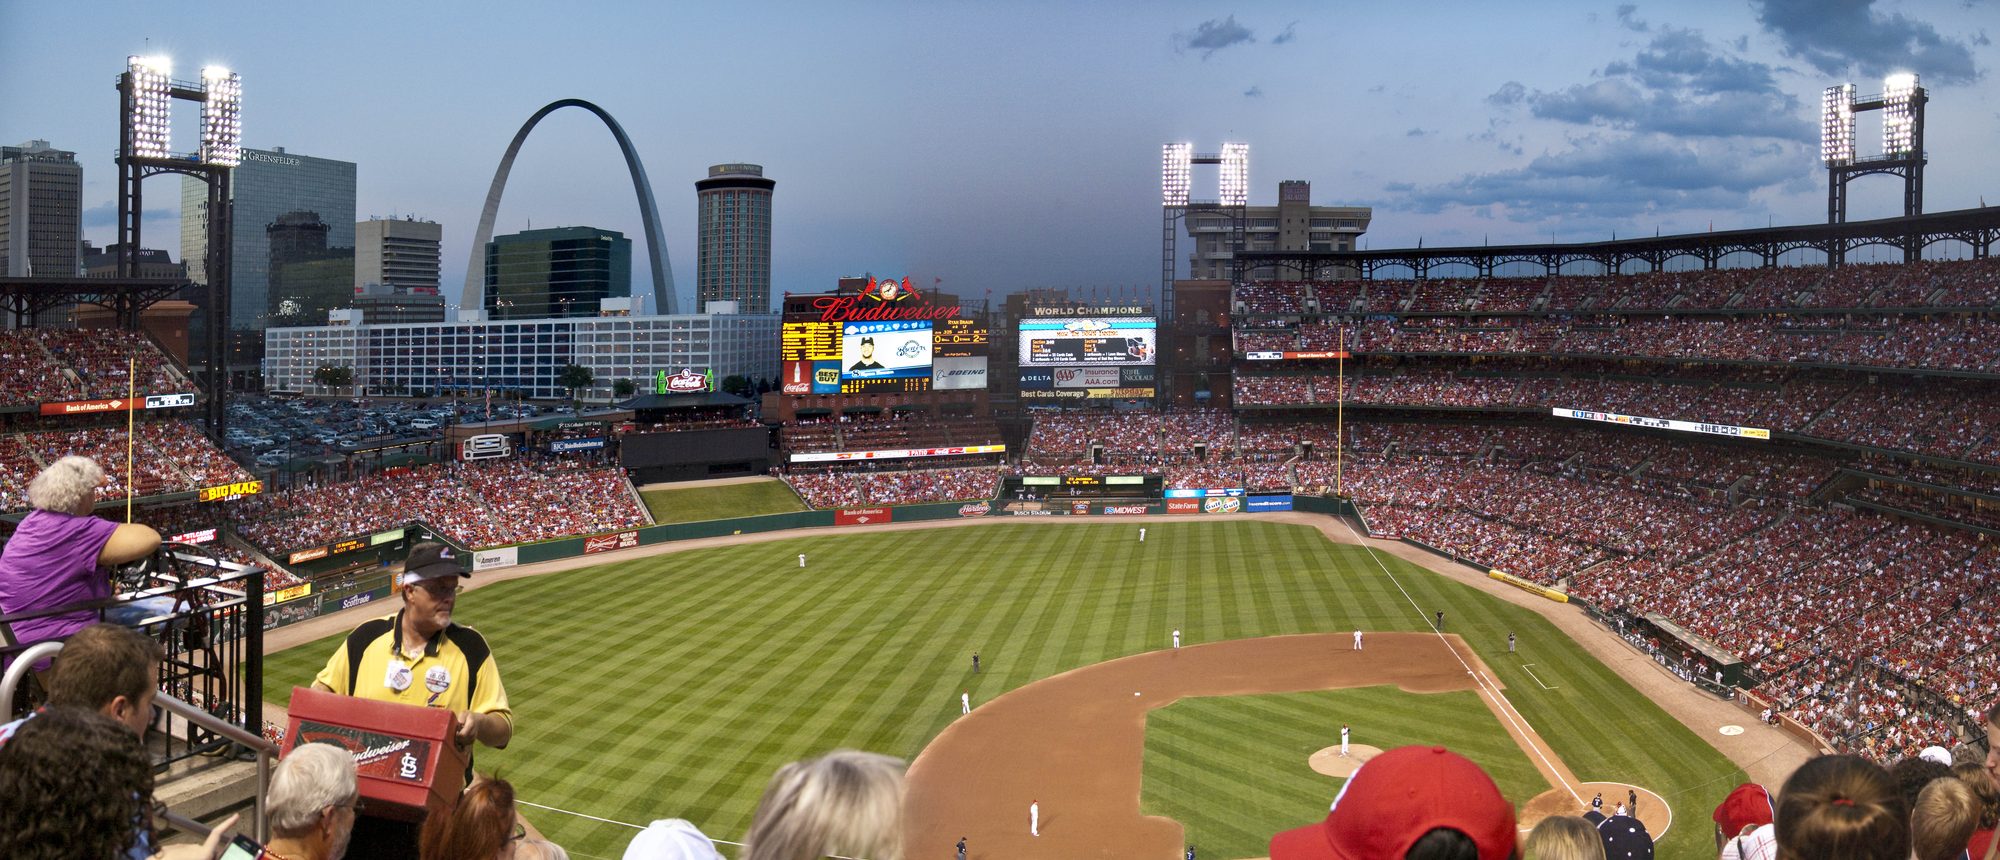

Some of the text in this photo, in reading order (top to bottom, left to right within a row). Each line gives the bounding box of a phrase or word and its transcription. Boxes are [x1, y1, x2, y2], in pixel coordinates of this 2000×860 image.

[812, 297, 960, 321] Budweiser
[1035, 307, 1142, 315] WORLD CHAMPIONS
[784, 383, 810, 392] Coca-Cola
[208, 482, 257, 500] BIG MAC
[481, 556, 500, 564] Ameren
[350, 740, 410, 761] udweiser
